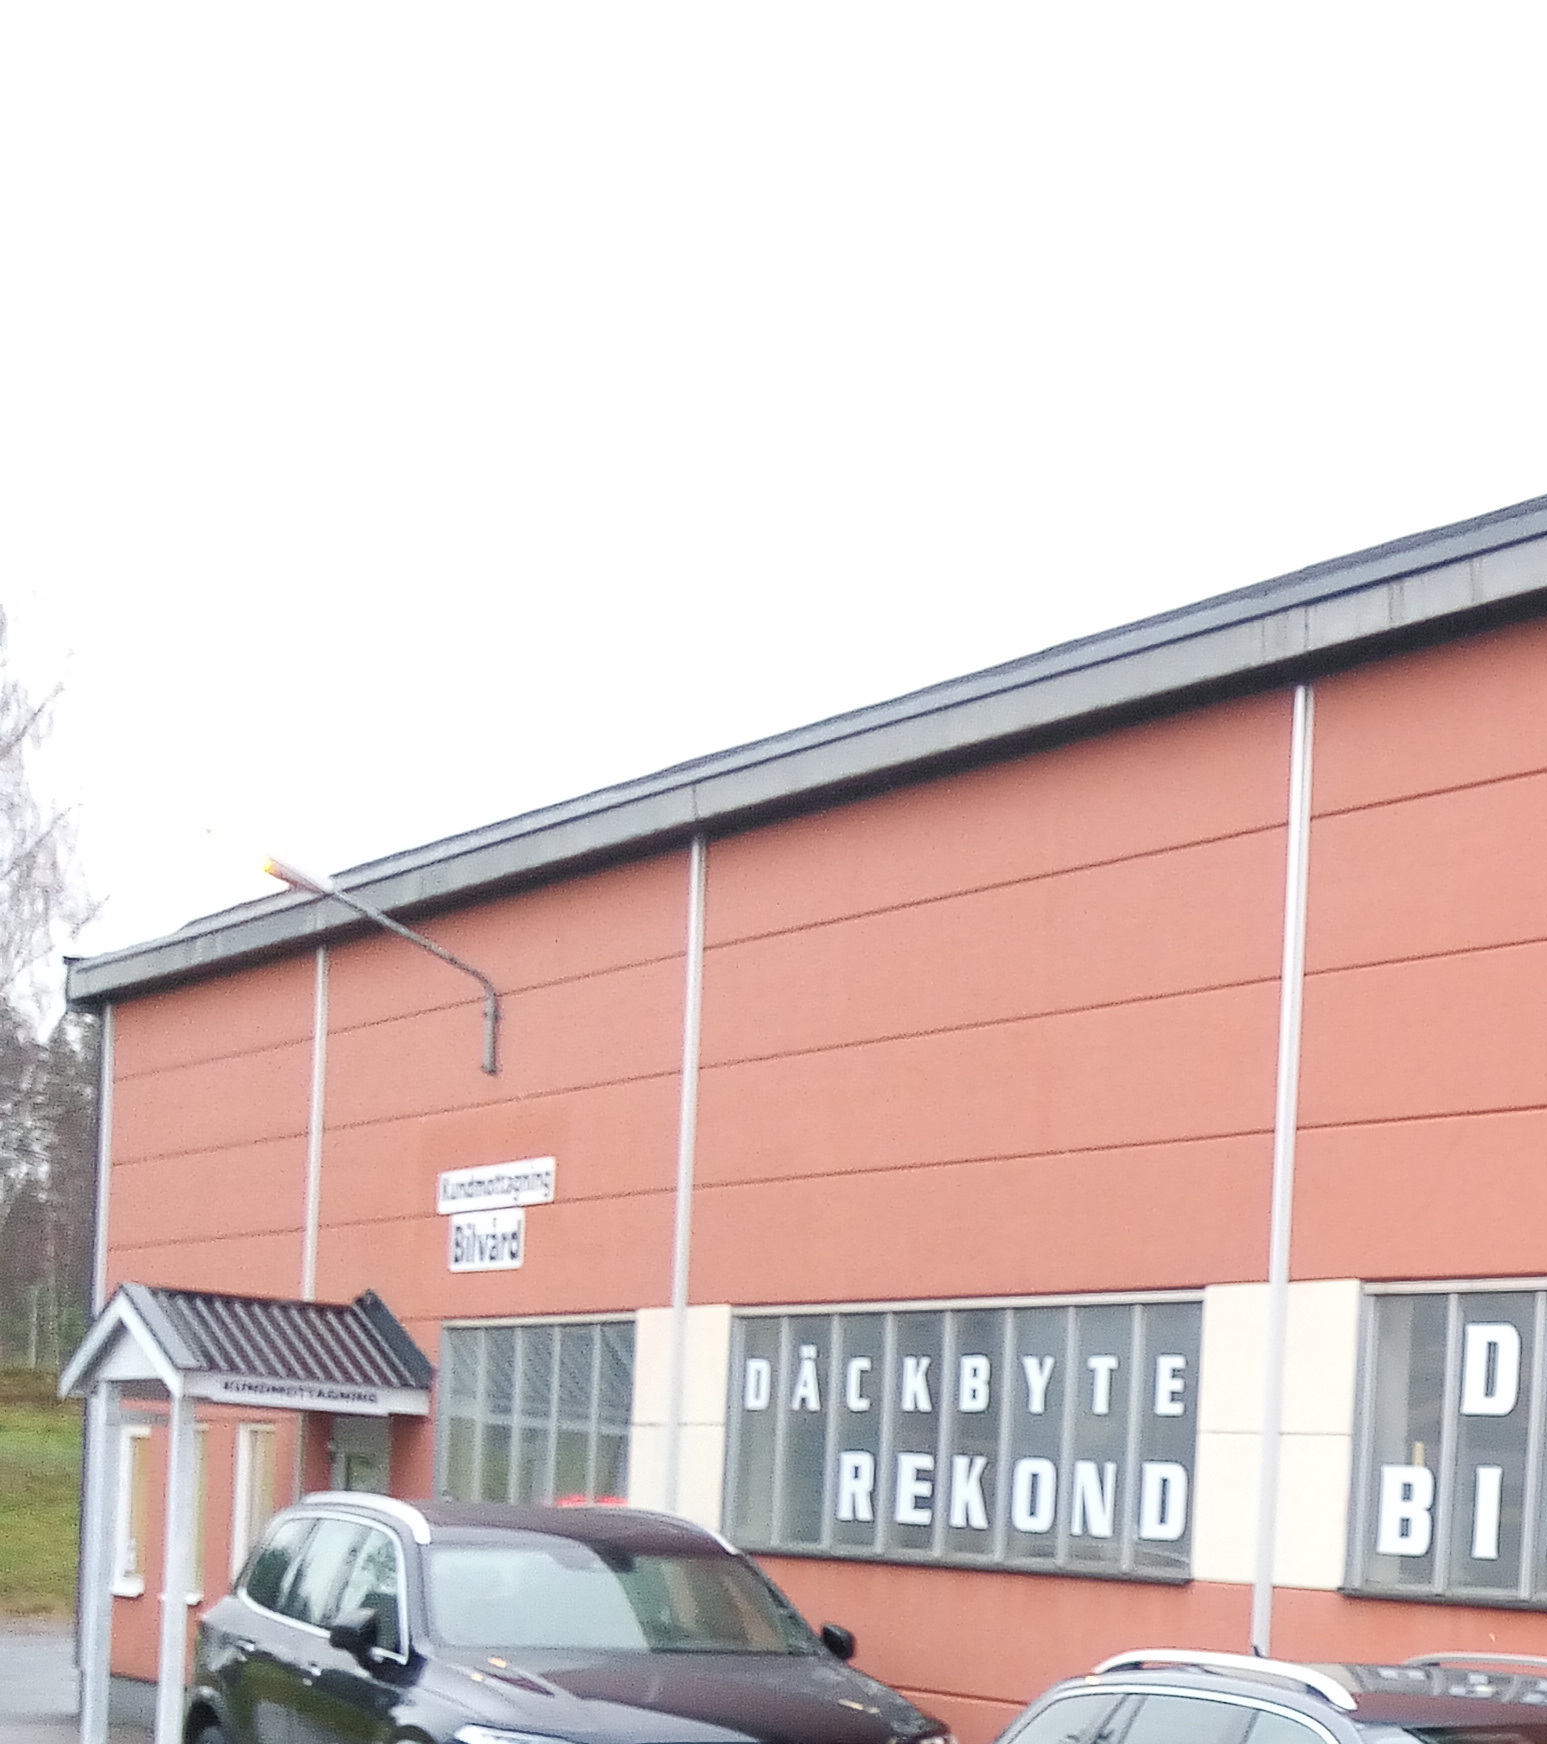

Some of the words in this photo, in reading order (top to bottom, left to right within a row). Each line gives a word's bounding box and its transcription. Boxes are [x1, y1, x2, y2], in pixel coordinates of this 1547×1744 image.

[441, 1170, 552, 1202] Kundmottagning
[453, 1216, 522, 1265] Bilvård
[744, 1343, 1188, 1418] DÄCKBYTE
[836, 1449, 1189, 1542] REKOND
